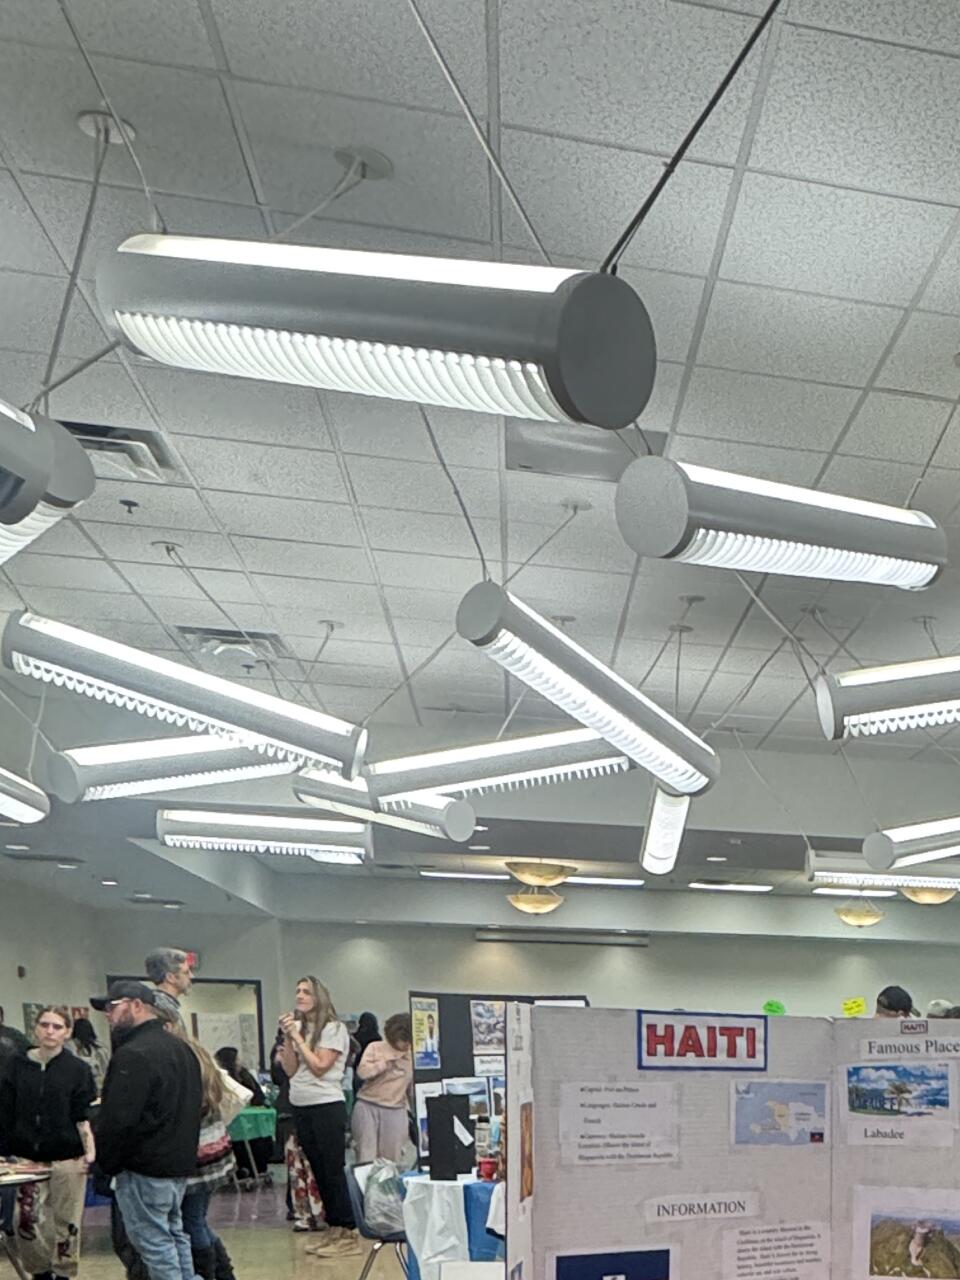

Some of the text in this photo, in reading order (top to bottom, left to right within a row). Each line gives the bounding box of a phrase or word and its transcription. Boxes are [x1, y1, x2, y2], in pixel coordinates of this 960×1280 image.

[646, 1024, 756, 1059] HAITI
[868, 1041, 921, 1055] Famous
[864, 1127, 905, 1139] Labadee
[656, 1201, 747, 1217] INFORMATION
